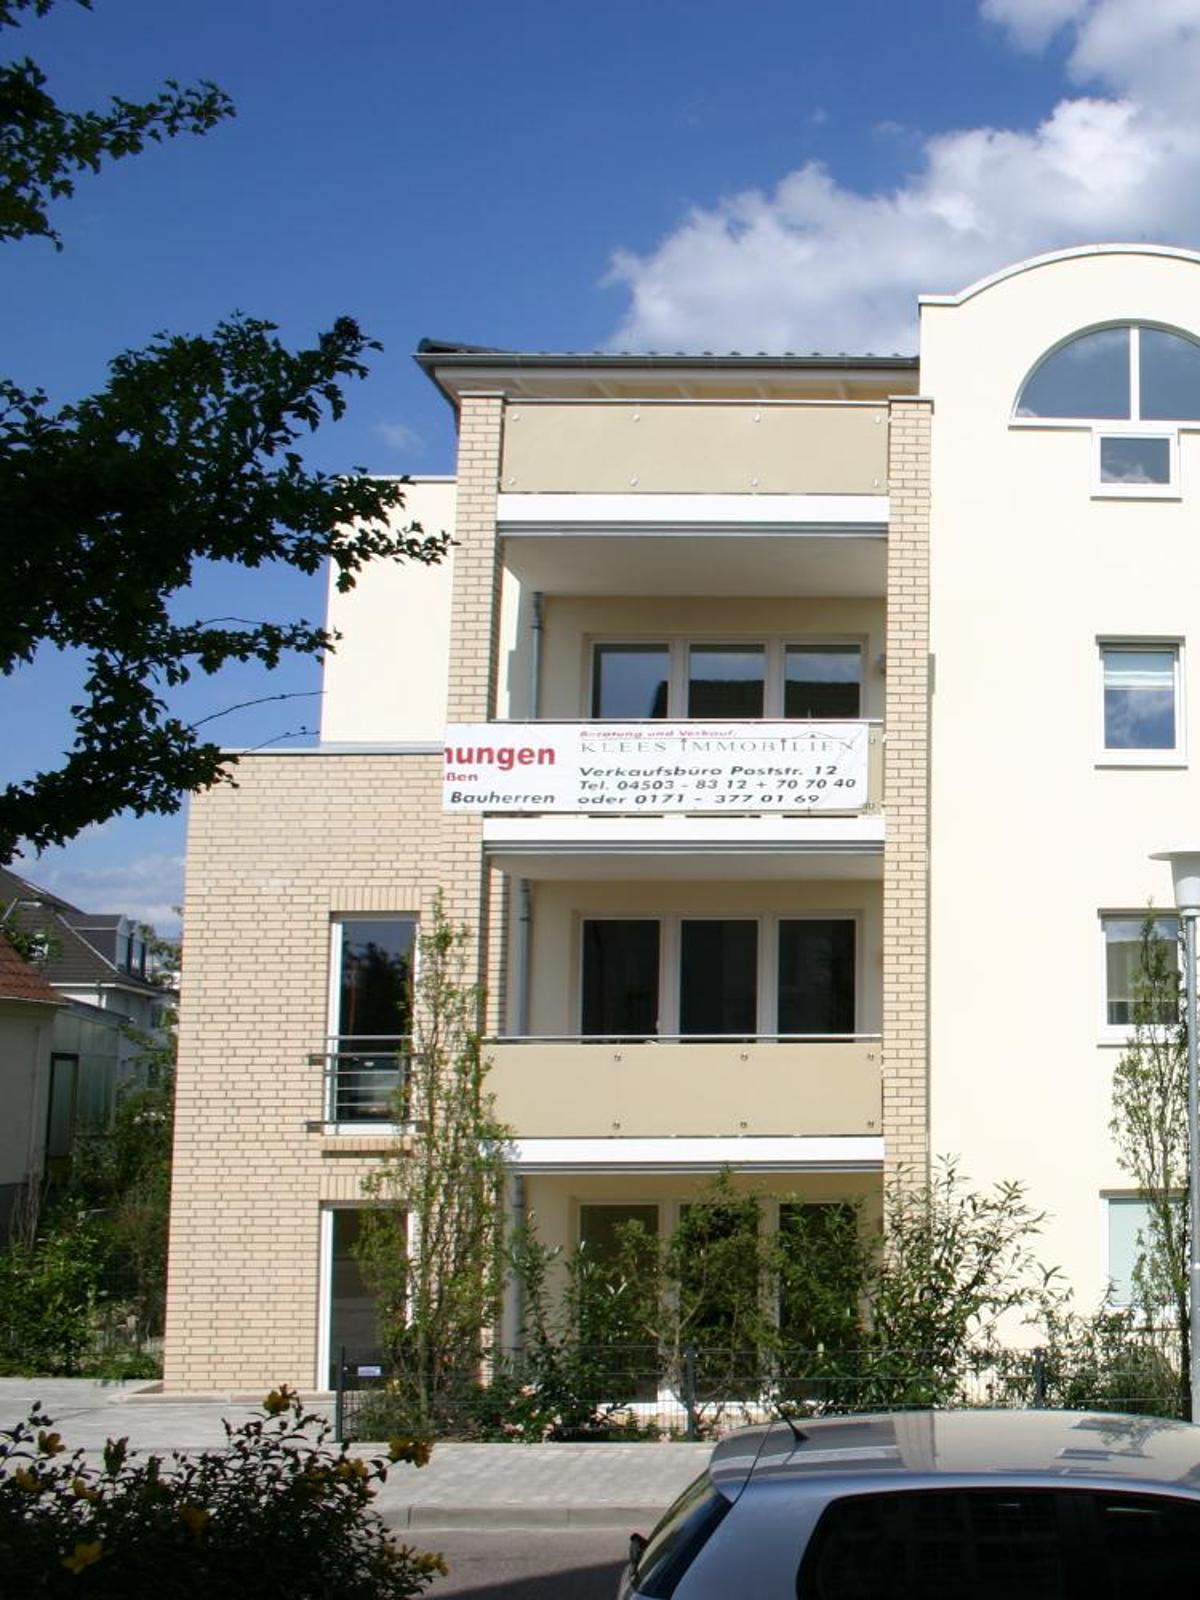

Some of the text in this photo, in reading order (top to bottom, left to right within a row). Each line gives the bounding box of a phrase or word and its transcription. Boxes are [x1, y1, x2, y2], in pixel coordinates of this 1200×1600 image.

[581, 738, 860, 753] KLEES IMMOBILIEN
[443, 772, 479, 782] ßen
[579, 766, 838, 777] Verkaufsbüro Poststr. 12
[579, 780, 610, 790] Tel.
[617, 779, 675, 790] 04503
[695, 780, 719, 790] 83
[727, 780, 748, 789] 12
[776, 779, 799, 789] 70
[806, 779, 828, 789] 70
[834, 778, 857, 788] 40
[450, 791, 555, 804] Bauherren
[578, 794, 626, 804] oder
[634, 794, 685, 804] 0171
[715, 794, 753, 804] 377
[760, 794, 785, 803] 01
[794, 794, 821, 803] 69
